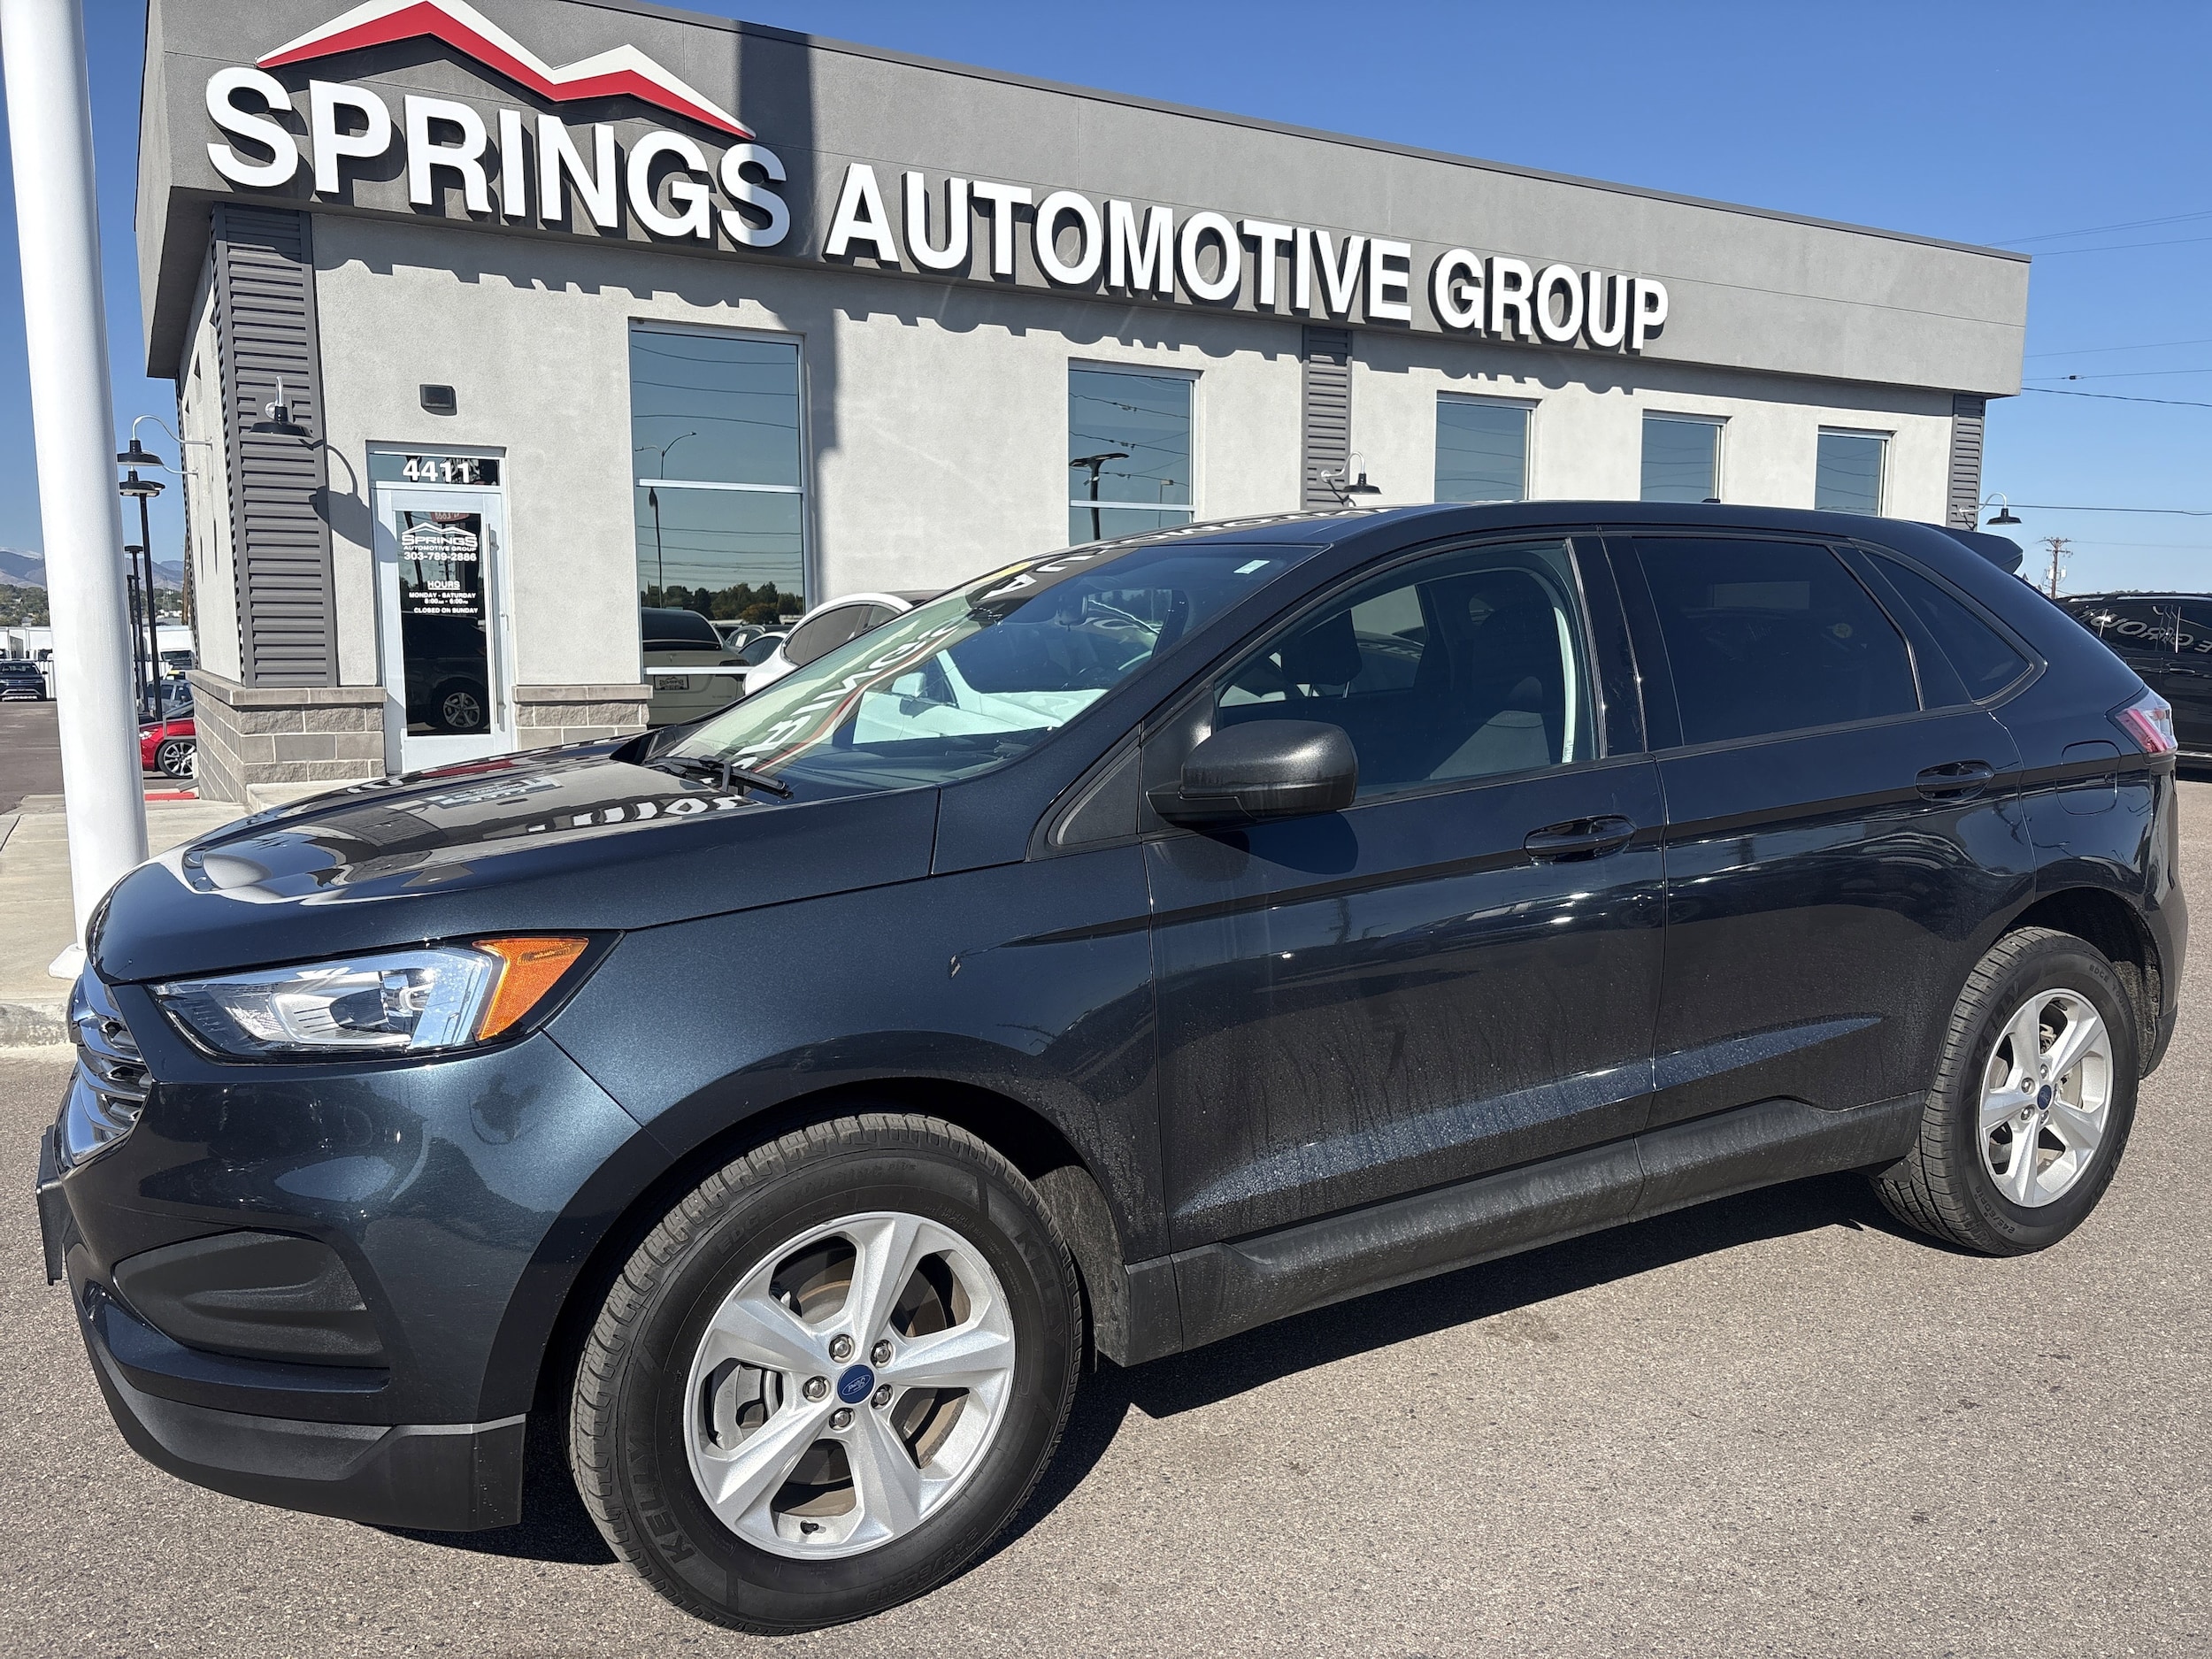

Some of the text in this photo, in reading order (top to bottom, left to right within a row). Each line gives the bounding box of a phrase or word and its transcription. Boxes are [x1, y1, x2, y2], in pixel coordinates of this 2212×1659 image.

[204, 66, 791, 249] SPRINGS
[824, 162, 1670, 351] AUTOMOTIVE GROUP
[403, 458, 470, 483] 4411
[402, 534, 478, 547] SPRINGS
[403, 552, 477, 561] 303-789-2886
[426, 580, 460, 589] HOURS
[719, 1206, 773, 1255] EDGE
[1015, 1229, 1065, 1346] KELLY
[627, 1437, 696, 1563] KELLY
